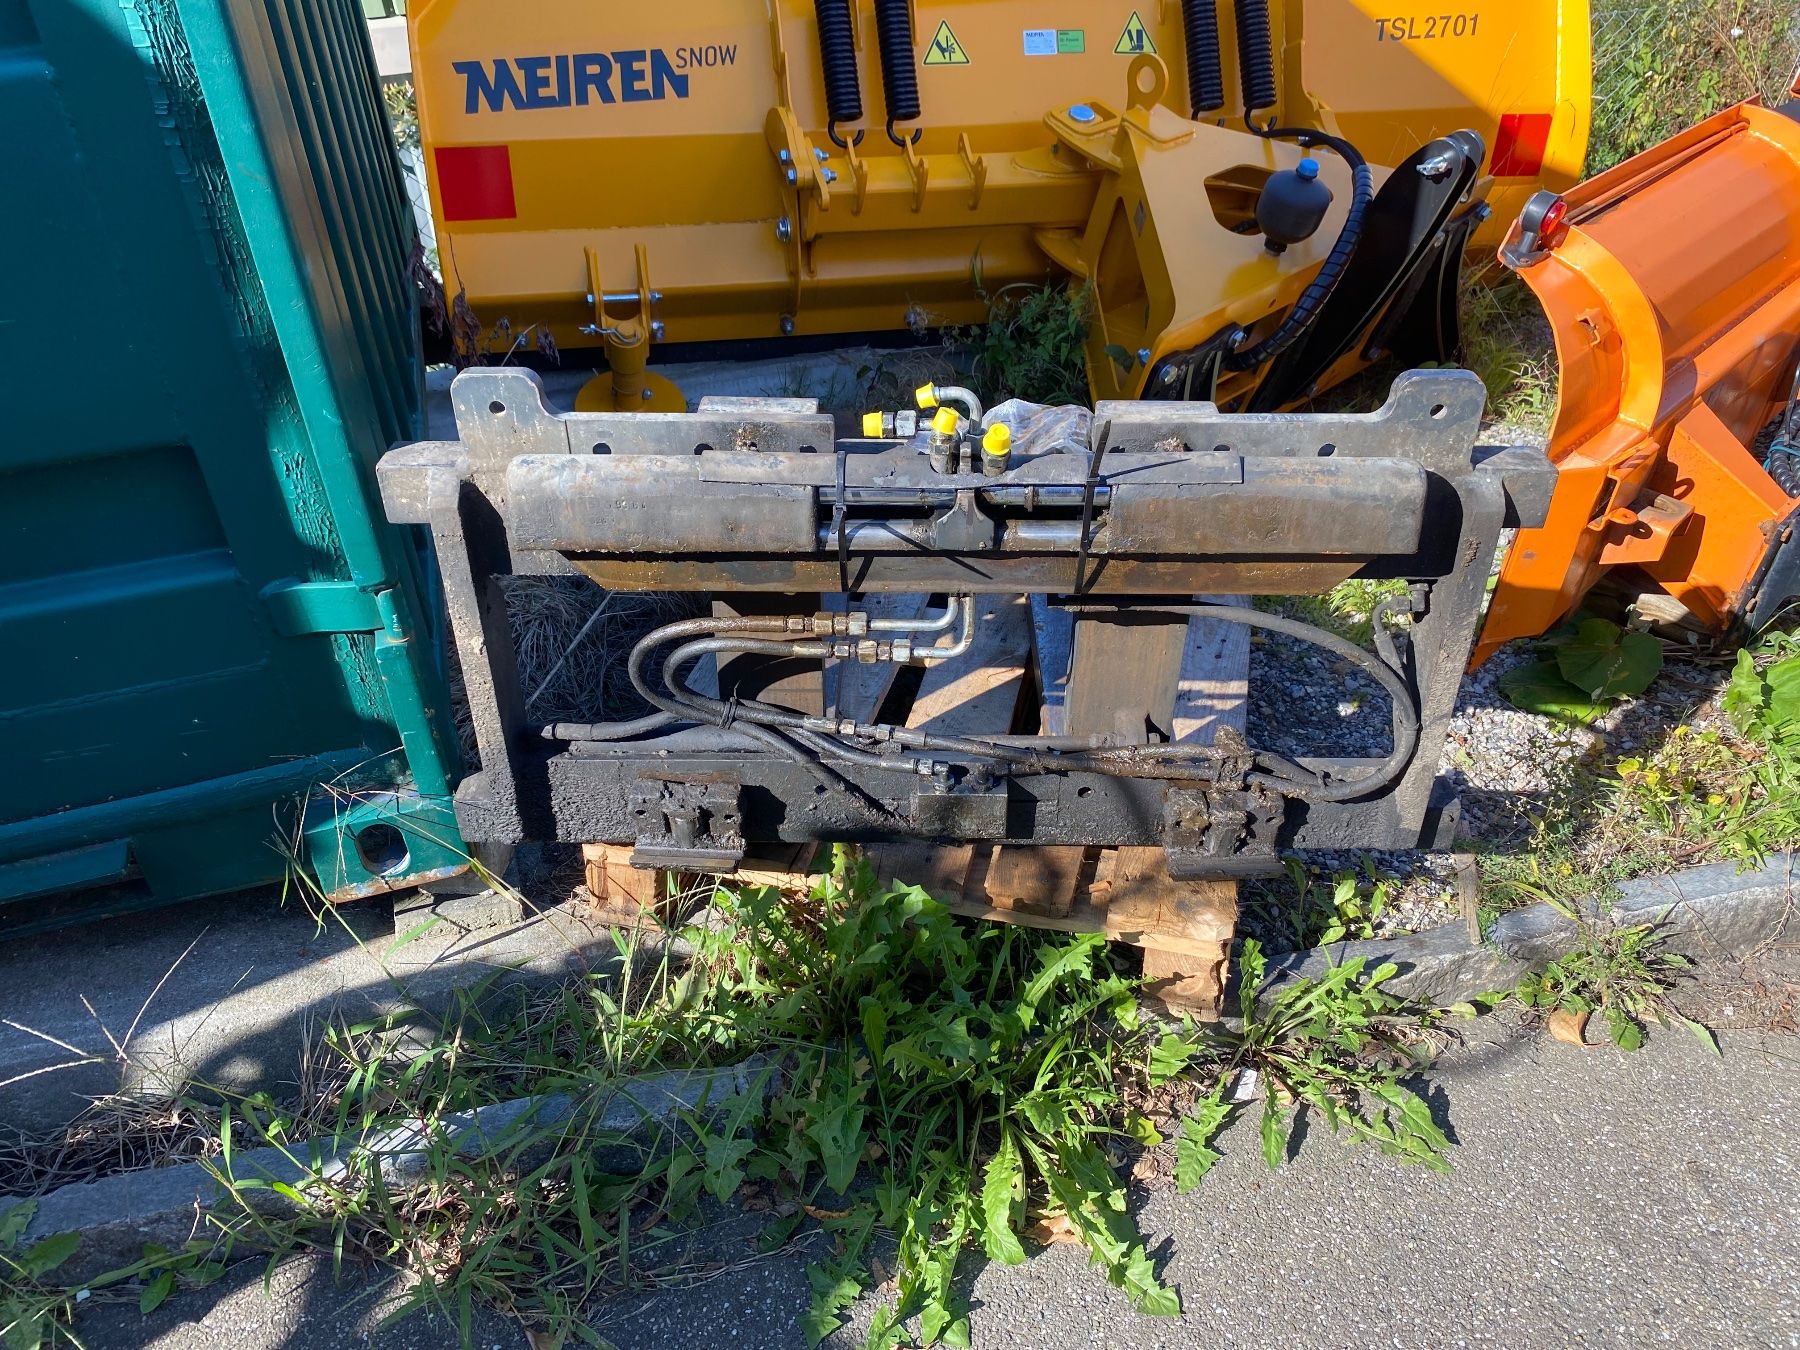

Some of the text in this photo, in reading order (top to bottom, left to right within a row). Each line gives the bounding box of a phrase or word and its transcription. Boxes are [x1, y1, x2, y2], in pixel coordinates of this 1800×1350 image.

[1375, 13, 1479, 42] TSL2701
[452, 44, 738, 114] MEIREN SNOW
